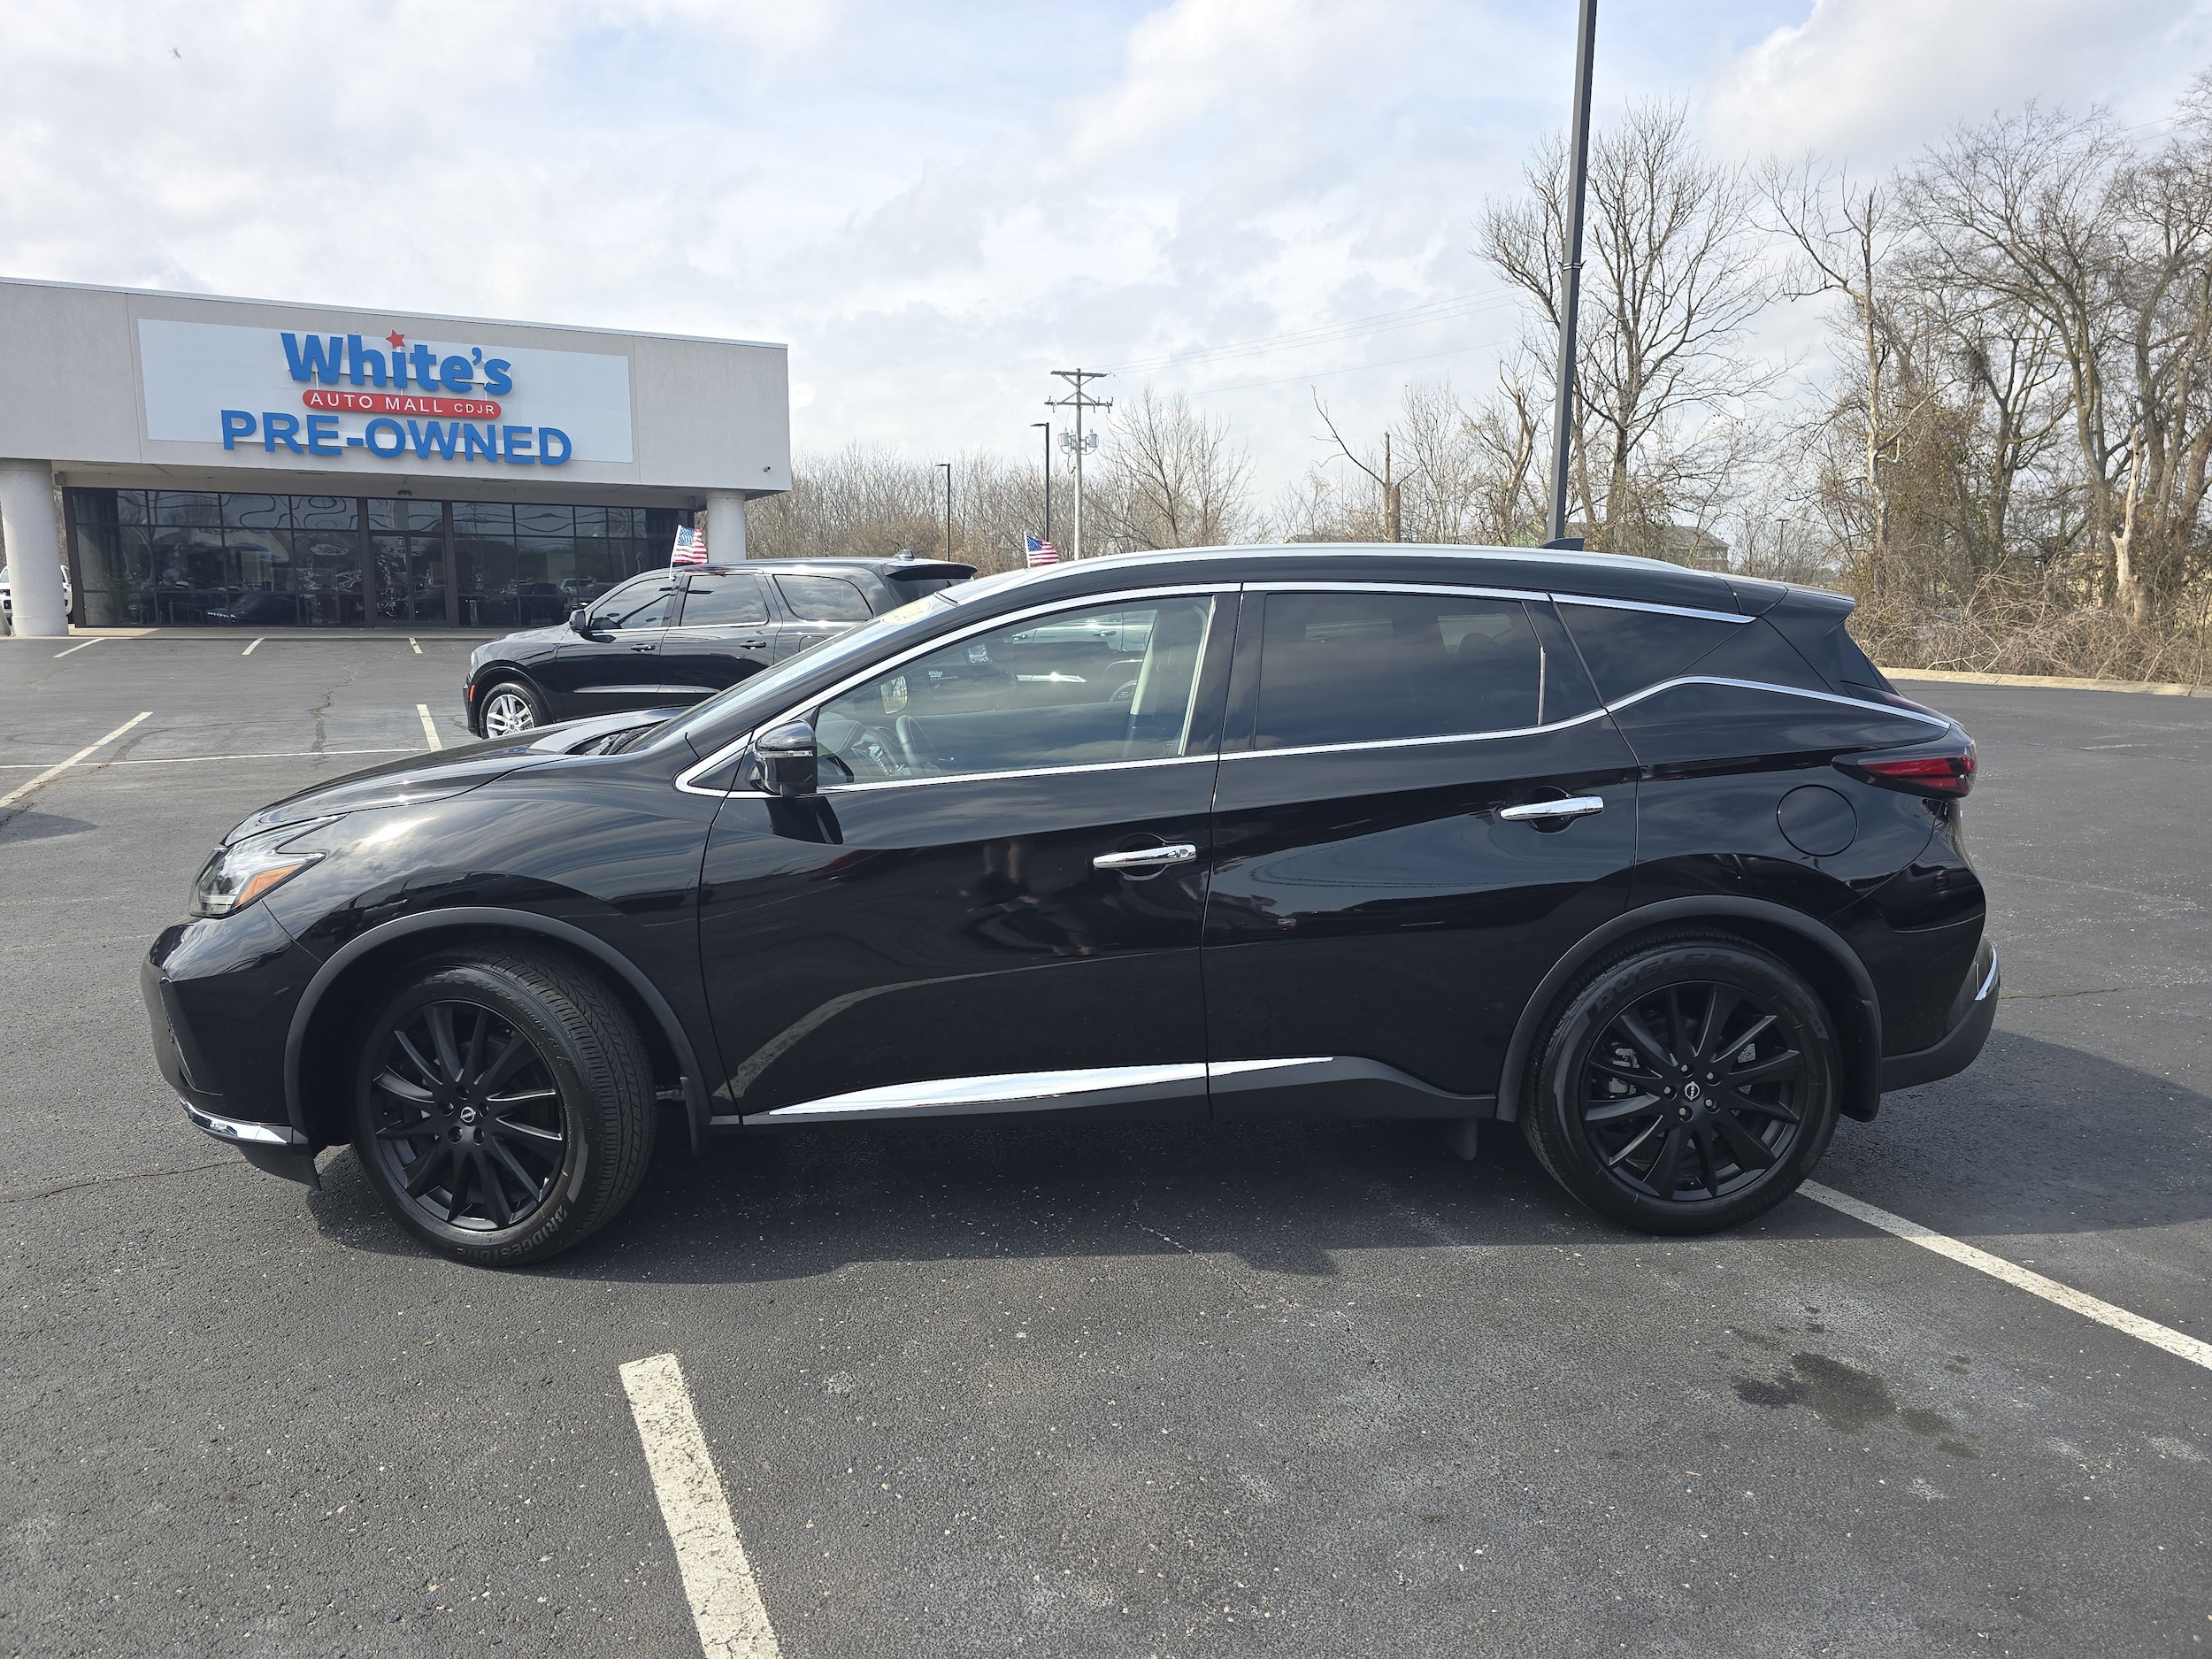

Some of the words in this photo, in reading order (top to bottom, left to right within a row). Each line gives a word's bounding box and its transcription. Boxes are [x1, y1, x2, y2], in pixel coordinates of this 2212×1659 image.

[280, 331, 513, 396] White's
[310, 392, 373, 410] AUTO
[385, 396, 443, 414] MALL
[454, 403, 495, 415] CDJR
[220, 410, 572, 465] PRE-OWNED
[1594, 953, 1732, 1011] DUELER
